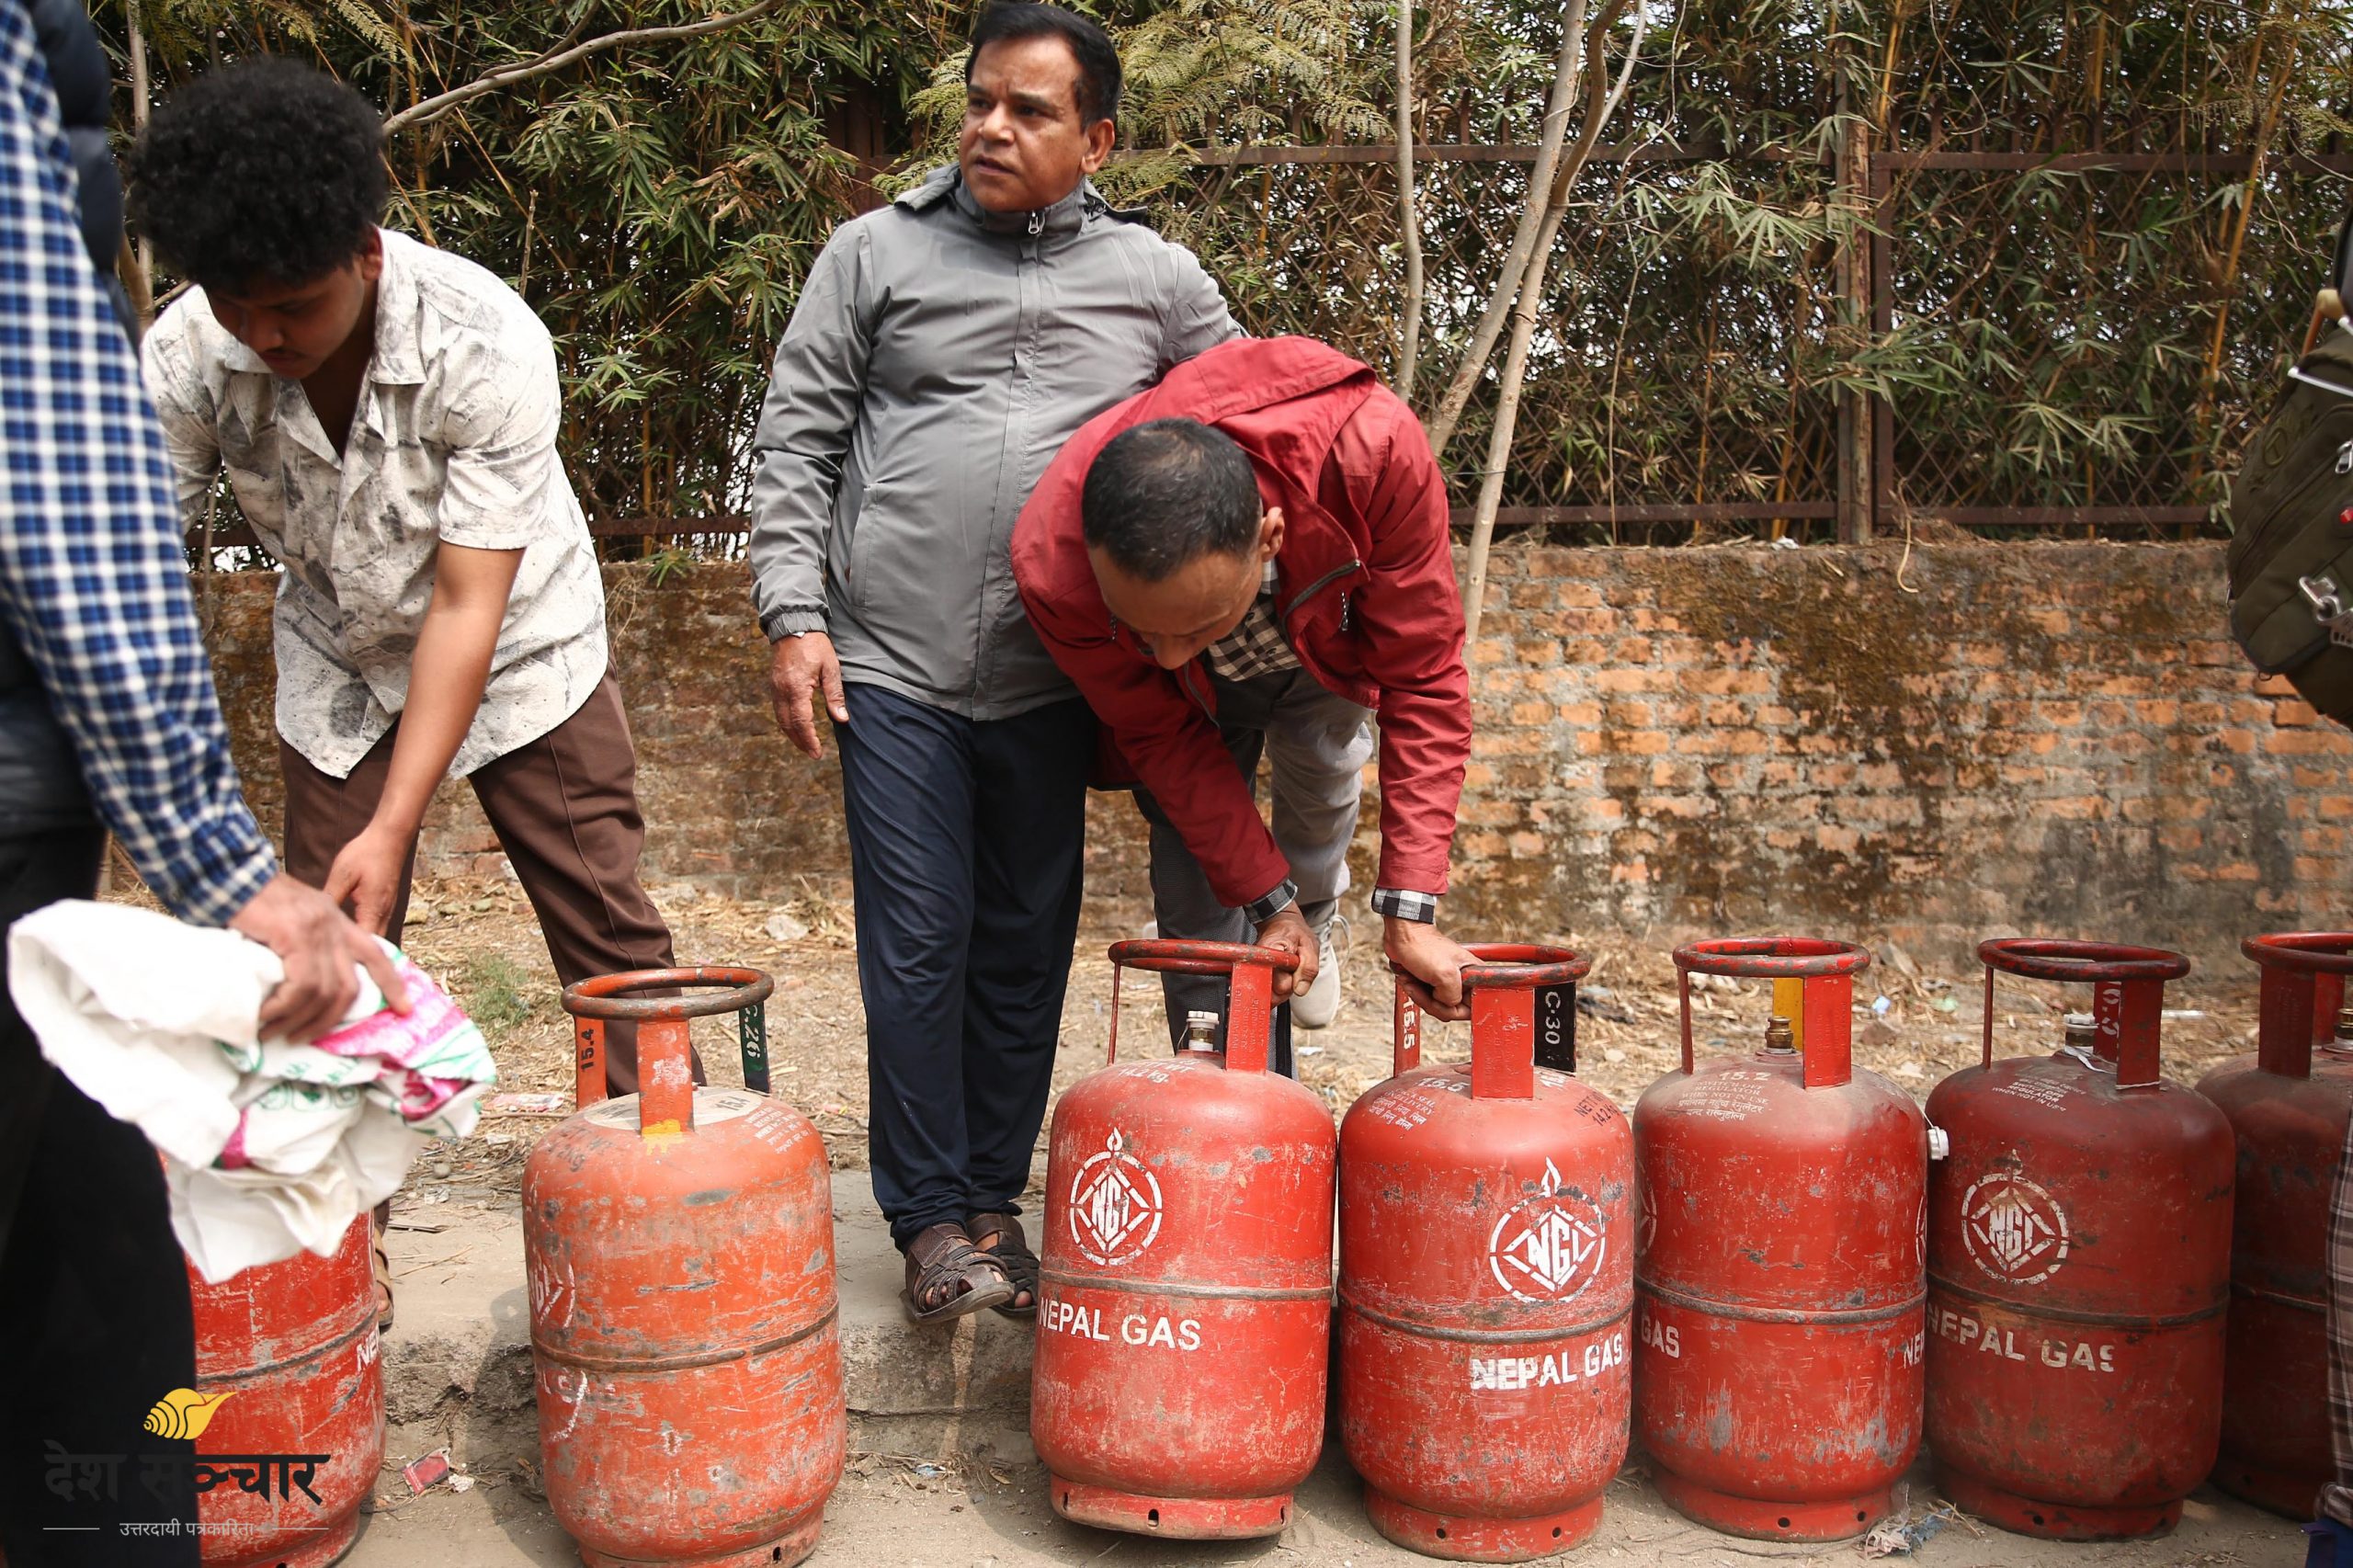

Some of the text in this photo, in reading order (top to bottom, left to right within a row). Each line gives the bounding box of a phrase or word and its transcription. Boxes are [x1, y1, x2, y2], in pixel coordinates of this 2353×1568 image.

[581, 1028, 595, 1071] 15.4
[1695, 1085, 1762, 1096] REGULATOR
[1720, 1072, 1772, 1081] 15.2
[1039, 1296, 1201, 1351] NEPAL GAS
[1641, 1314, 1680, 1358] GAS
[1927, 1302, 2114, 1372] NEPAL GAS
[1470, 1332, 1622, 1390] NEPAL GAS
